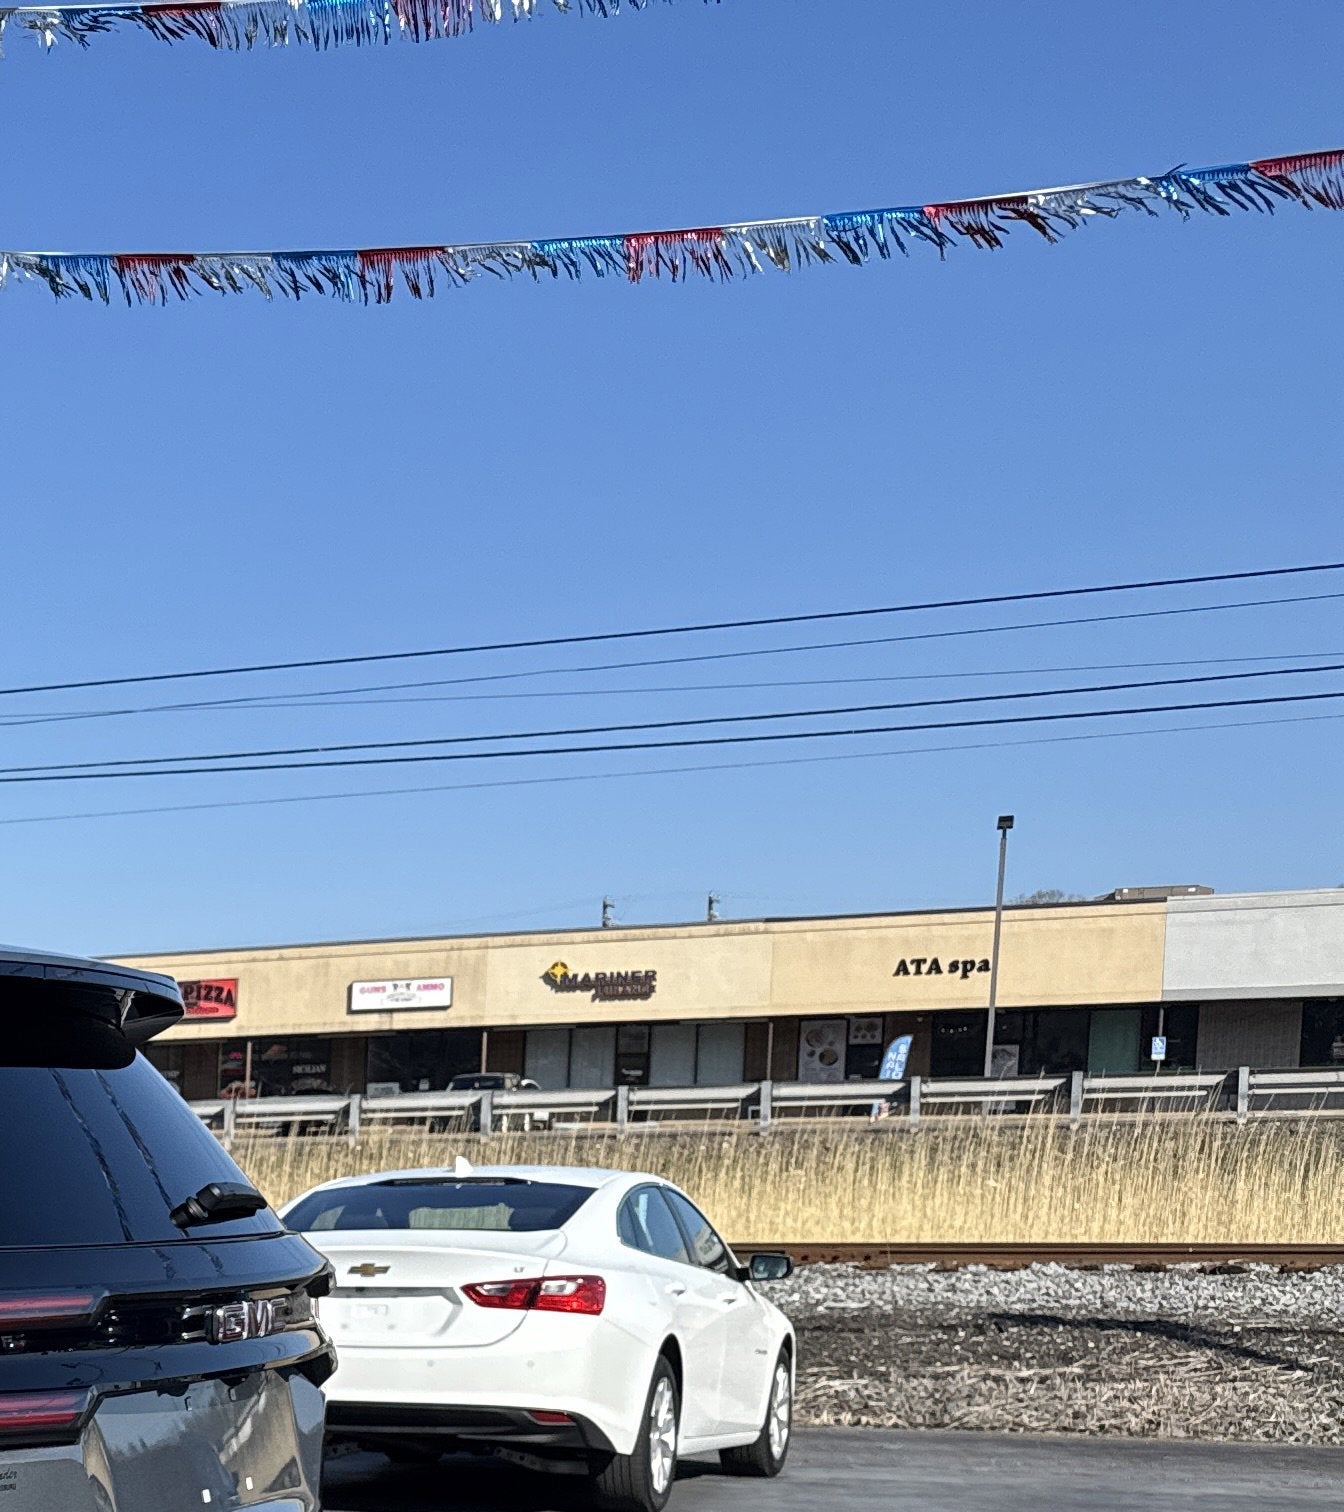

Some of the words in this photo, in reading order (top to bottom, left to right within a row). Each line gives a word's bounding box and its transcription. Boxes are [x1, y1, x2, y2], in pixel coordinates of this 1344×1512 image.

[892, 957, 943, 977] ATA
[947, 958, 991, 980] spa
[183, 983, 235, 1007] PIZZA
[416, 982, 445, 991] AMMO
[217, 1297, 287, 1343] GMC
